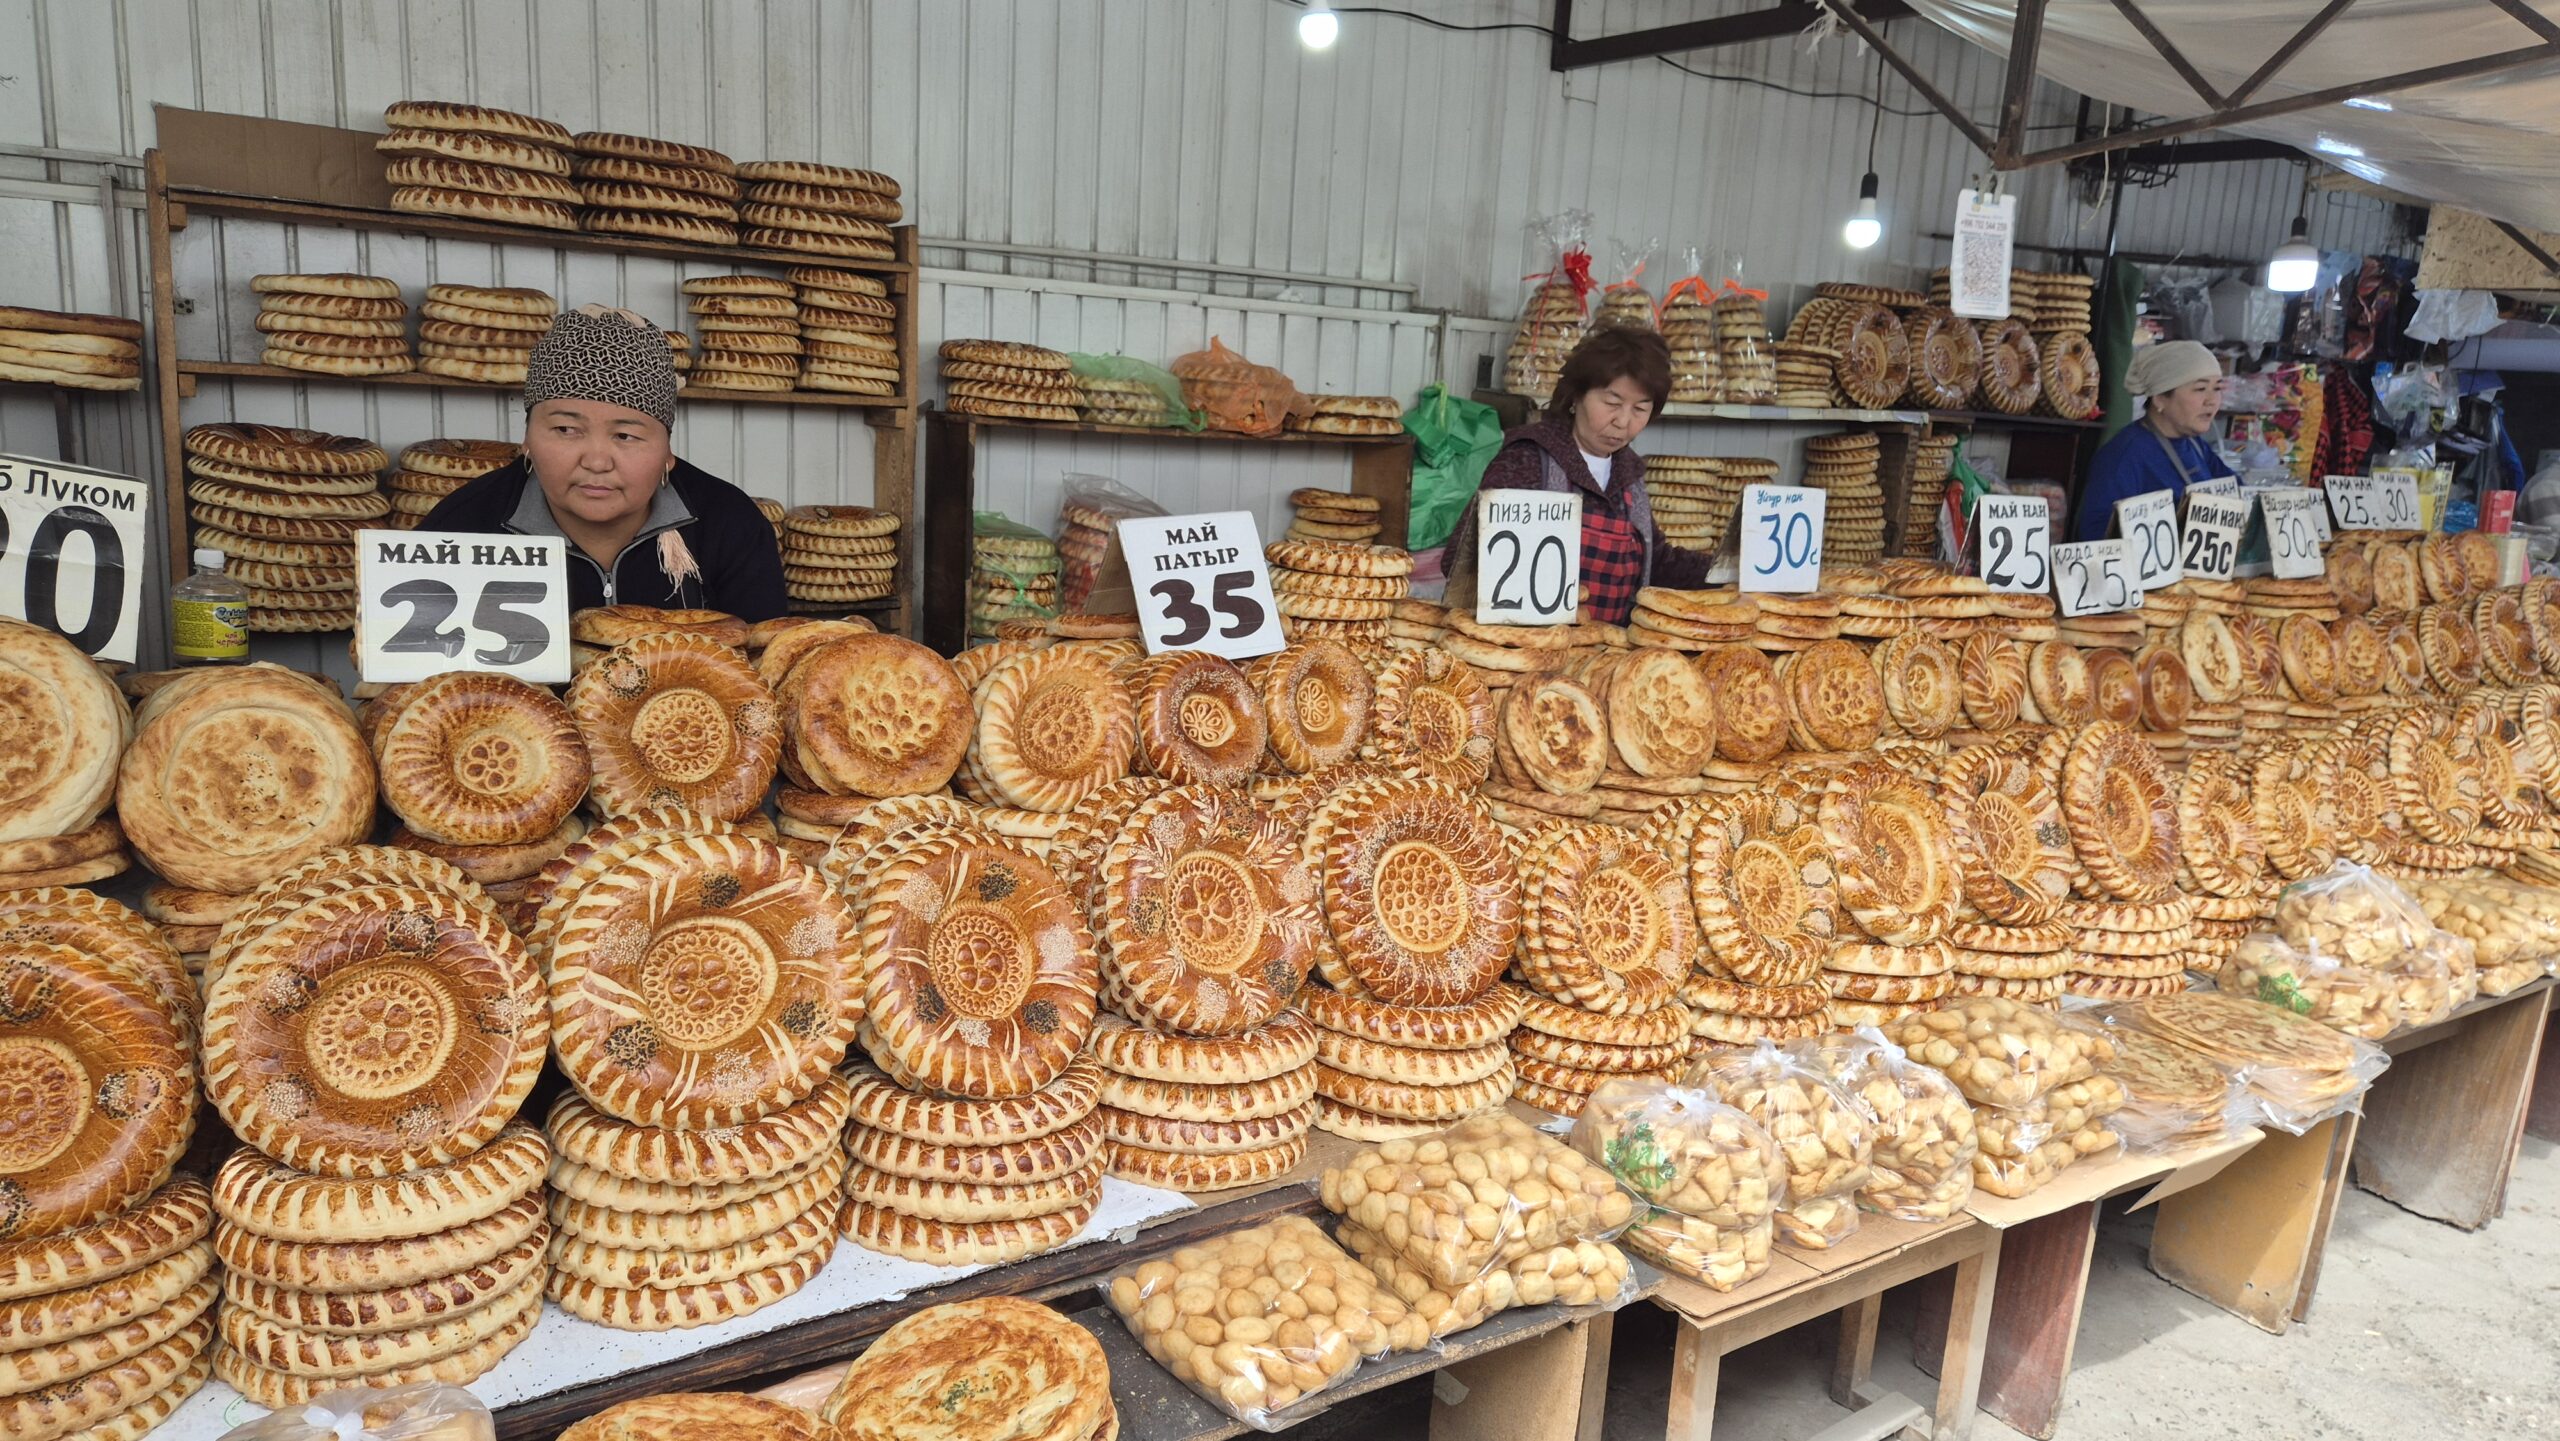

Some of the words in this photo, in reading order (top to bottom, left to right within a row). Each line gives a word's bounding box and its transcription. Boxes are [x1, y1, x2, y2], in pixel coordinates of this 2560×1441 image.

[1165, 521, 1218, 546] МАЙ
[1989, 501, 2018, 519] МАЙ
[2023, 504, 2047, 518] НАН
[0, 503, 125, 656] 0
[377, 539, 461, 565] МАЙ
[471, 545, 549, 567] НАН
[1154, 547, 1239, 571] ПАТЫР
[1986, 526, 2046, 589] 25
[2134, 520, 2175, 580] 20
[380, 579, 550, 666] 25
[1150, 570, 1265, 646] 35
